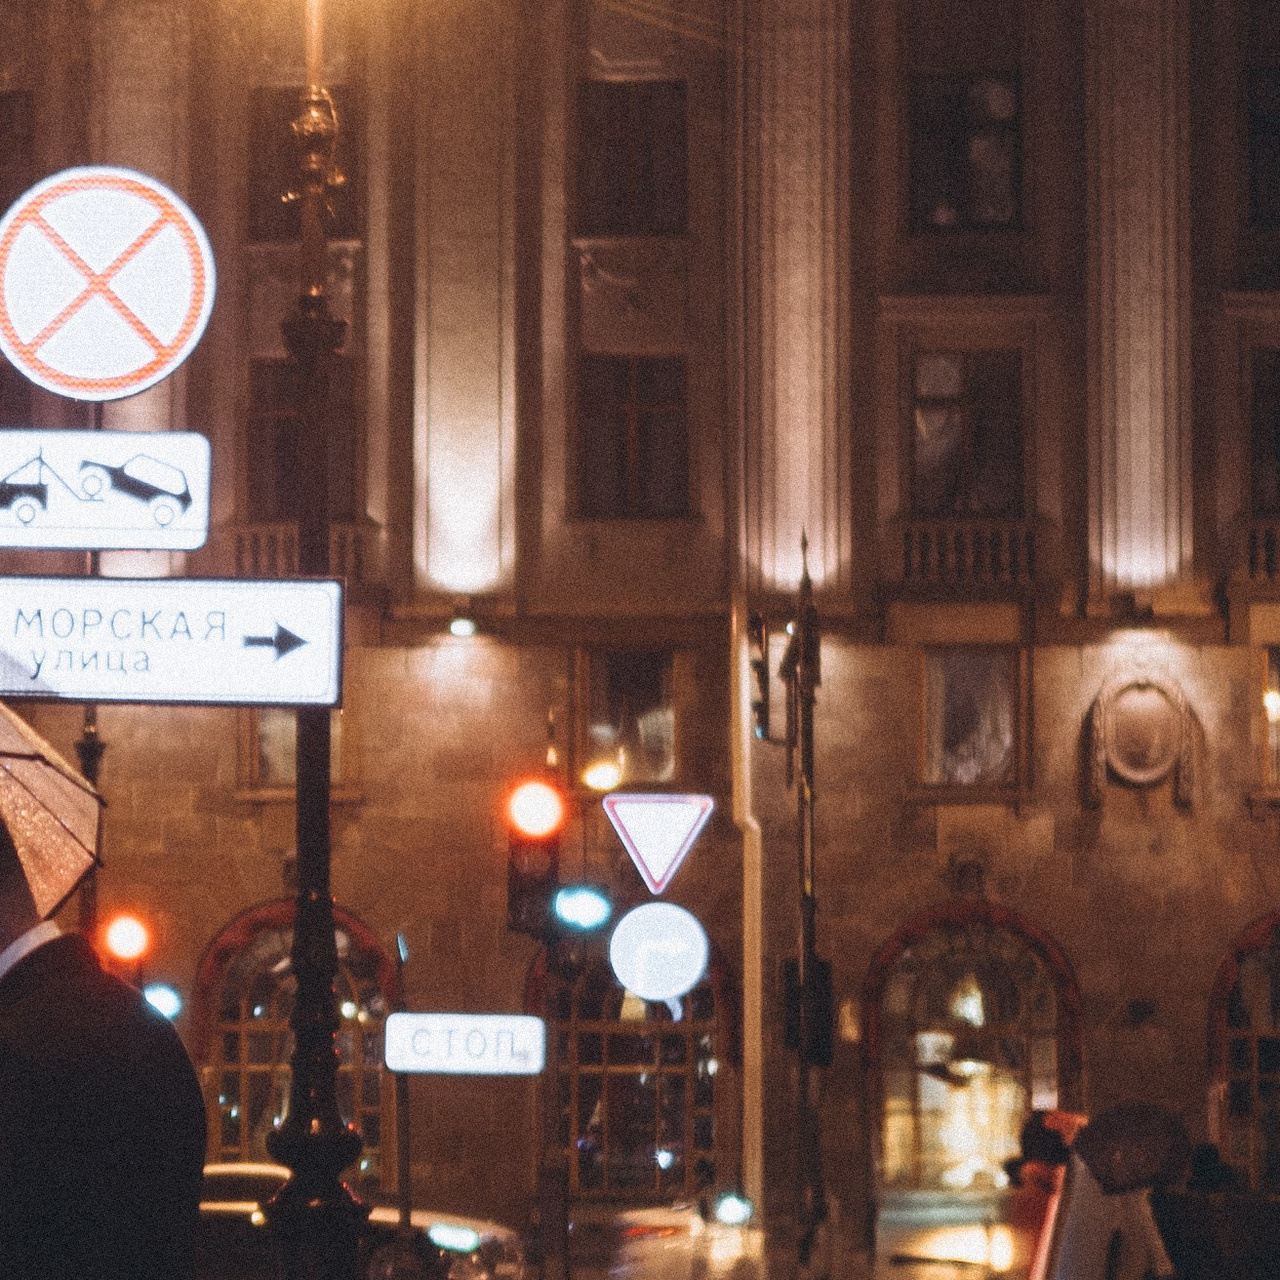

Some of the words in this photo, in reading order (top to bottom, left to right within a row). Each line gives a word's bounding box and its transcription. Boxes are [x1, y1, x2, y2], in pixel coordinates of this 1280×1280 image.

[14, 608, 226, 640] МОРСКАЯ
[30, 650, 151, 680] улица
[411, 1028, 516, 1059] СТОП
